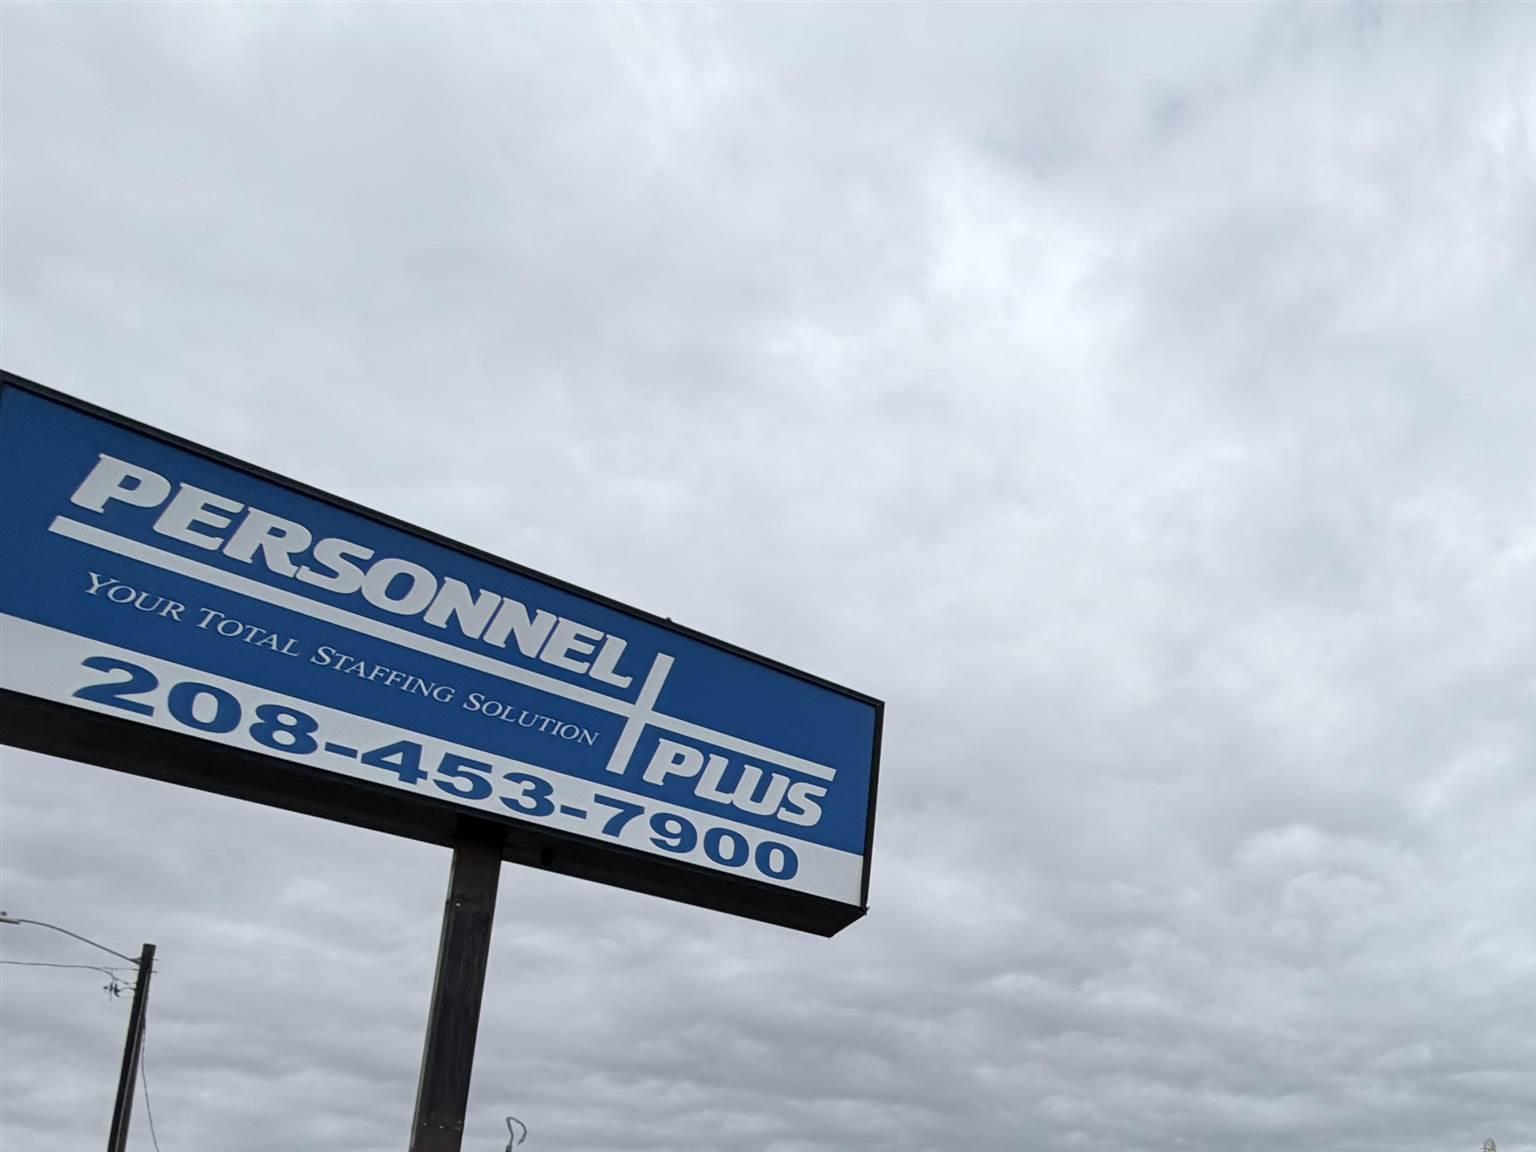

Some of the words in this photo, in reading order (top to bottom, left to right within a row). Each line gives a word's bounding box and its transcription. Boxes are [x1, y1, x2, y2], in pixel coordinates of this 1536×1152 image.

[70, 453, 634, 690] PERSONNEL
[84, 571, 185, 622] YOUR
[199, 606, 300, 657] TOTAL
[310, 646, 454, 704] STAFFING
[463, 692, 599, 748] SOLUTION
[72, 654, 801, 882] 208-453-7900
[642, 738, 828, 827] PLUS
